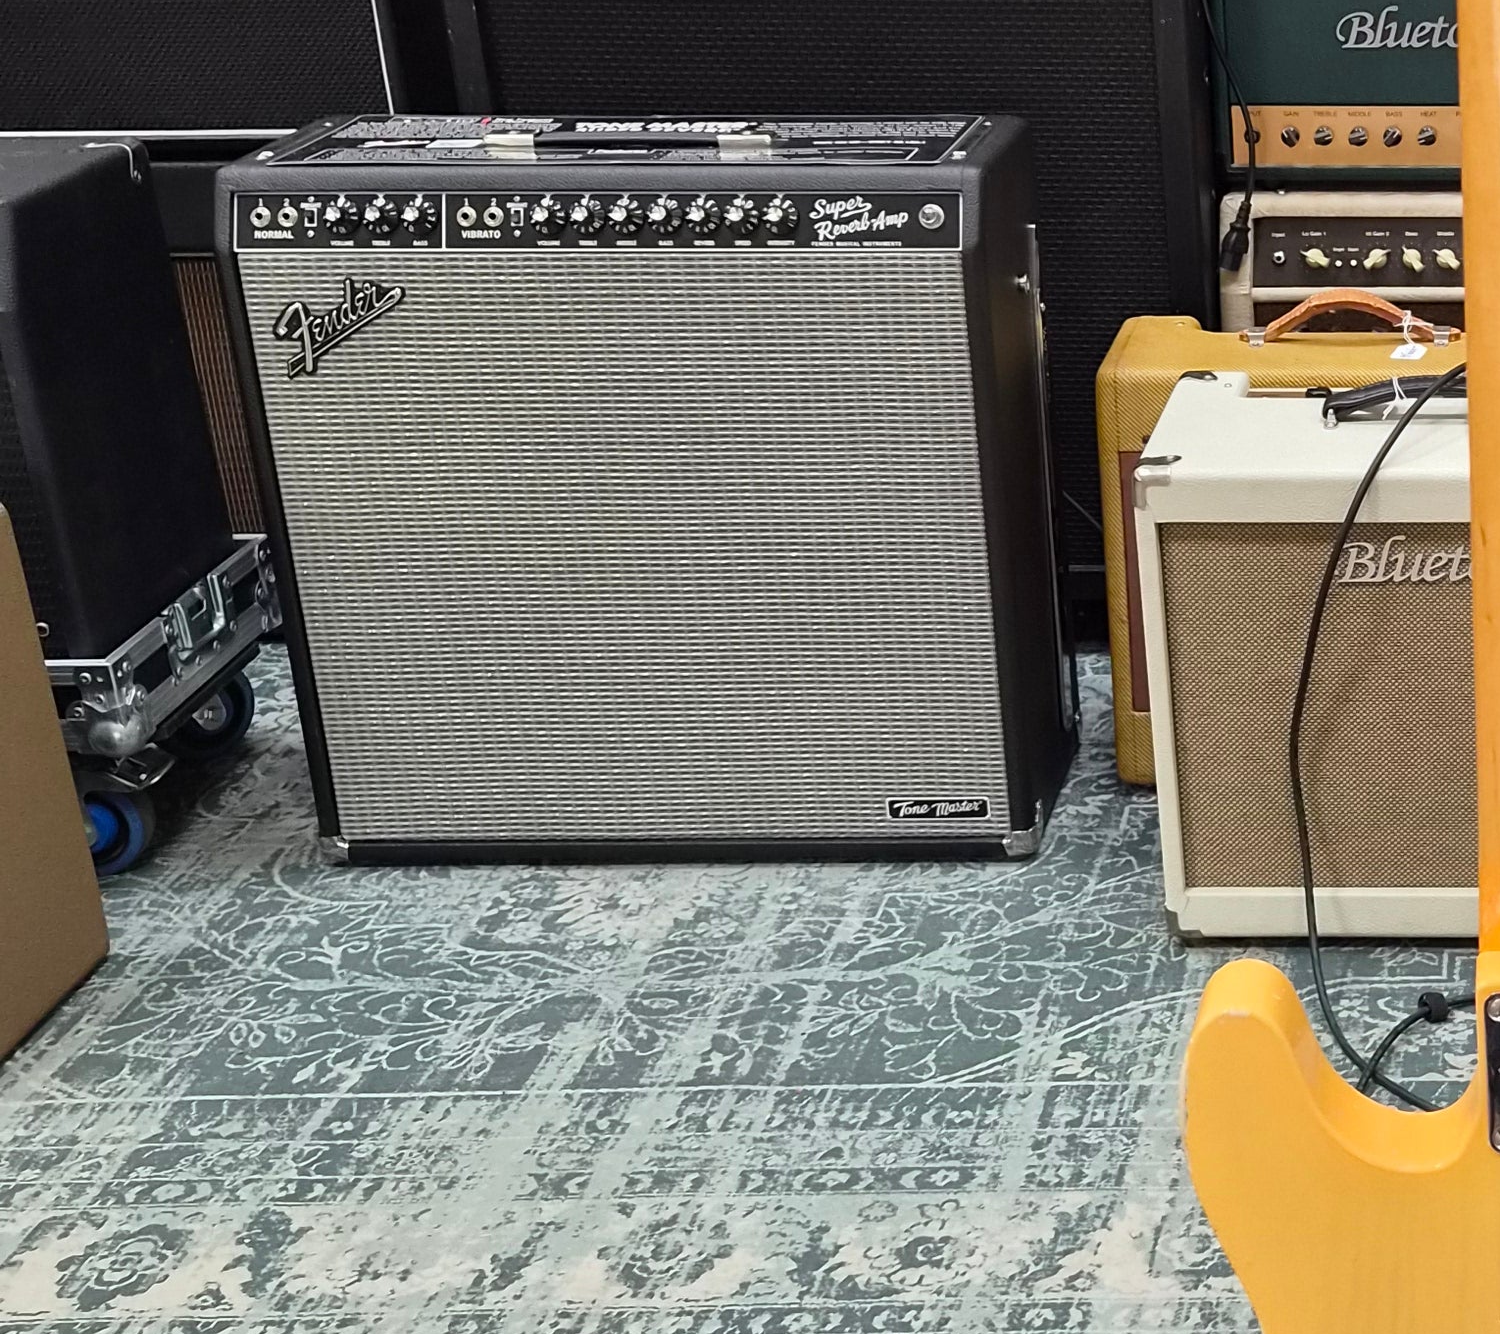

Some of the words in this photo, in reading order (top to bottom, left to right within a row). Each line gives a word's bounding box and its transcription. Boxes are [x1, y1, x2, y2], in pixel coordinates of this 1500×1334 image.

[808, 195, 873, 220] Super
[254, 230, 295, 239] NORMAL
[461, 230, 502, 239] VIBRATO
[813, 210, 909, 242] Reverb-Amp
[275, 278, 402, 376] Fender
[1337, 534, 1473, 583] Bluet
[893, 800, 931, 817] Tone
[931, 800, 982, 817] Master
